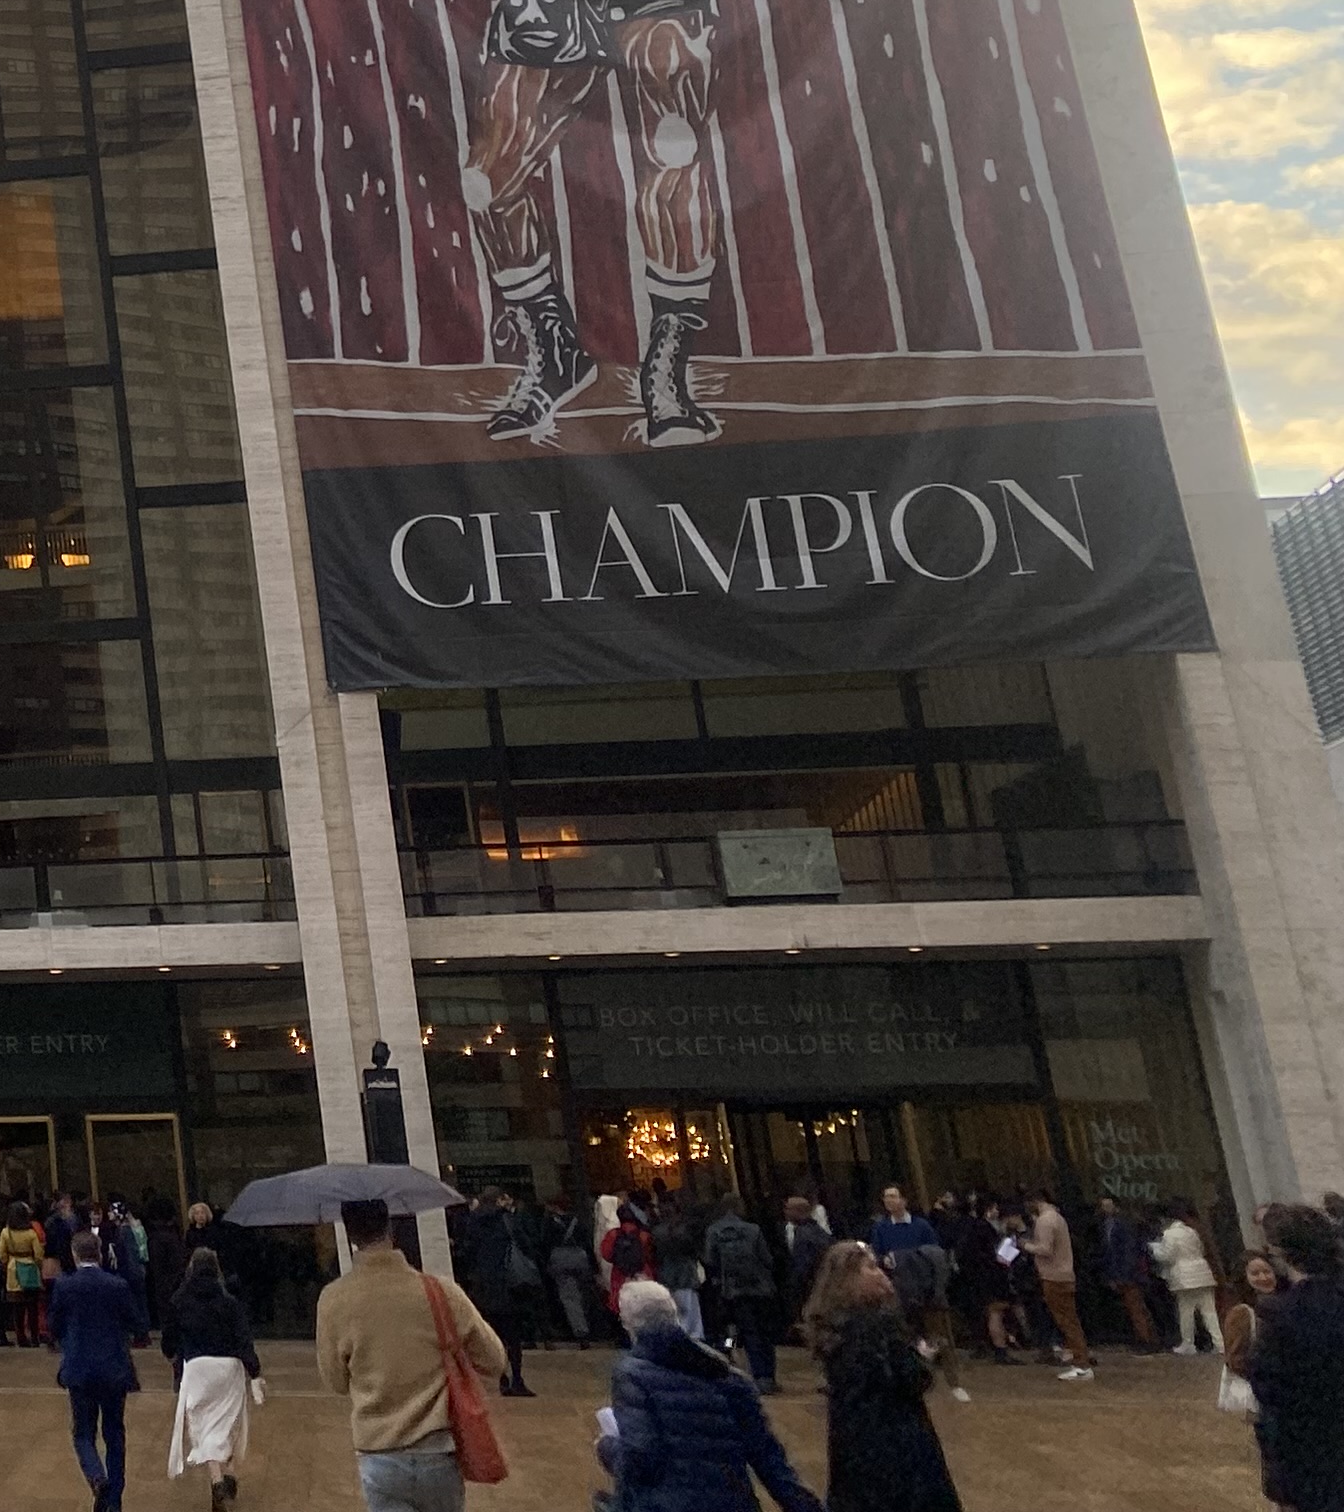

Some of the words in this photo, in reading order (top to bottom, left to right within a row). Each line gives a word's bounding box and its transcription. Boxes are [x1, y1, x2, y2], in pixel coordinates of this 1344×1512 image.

[390, 474, 1095, 608] CHAMPION
[599, 1007, 657, 1028] BOX
[788, 1003, 858, 1024] WILL
[961, 999, 981, 1021] &
[30, 1033, 110, 1055] ENTRY
[628, 1034, 856, 1057] TICKET-HOLDER
[867, 1032, 958, 1054] ENTRY
[1089, 1120, 1143, 1145] Met
[1094, 1147, 1182, 1177] Opera
[1101, 1173, 1159, 1202] Shop
